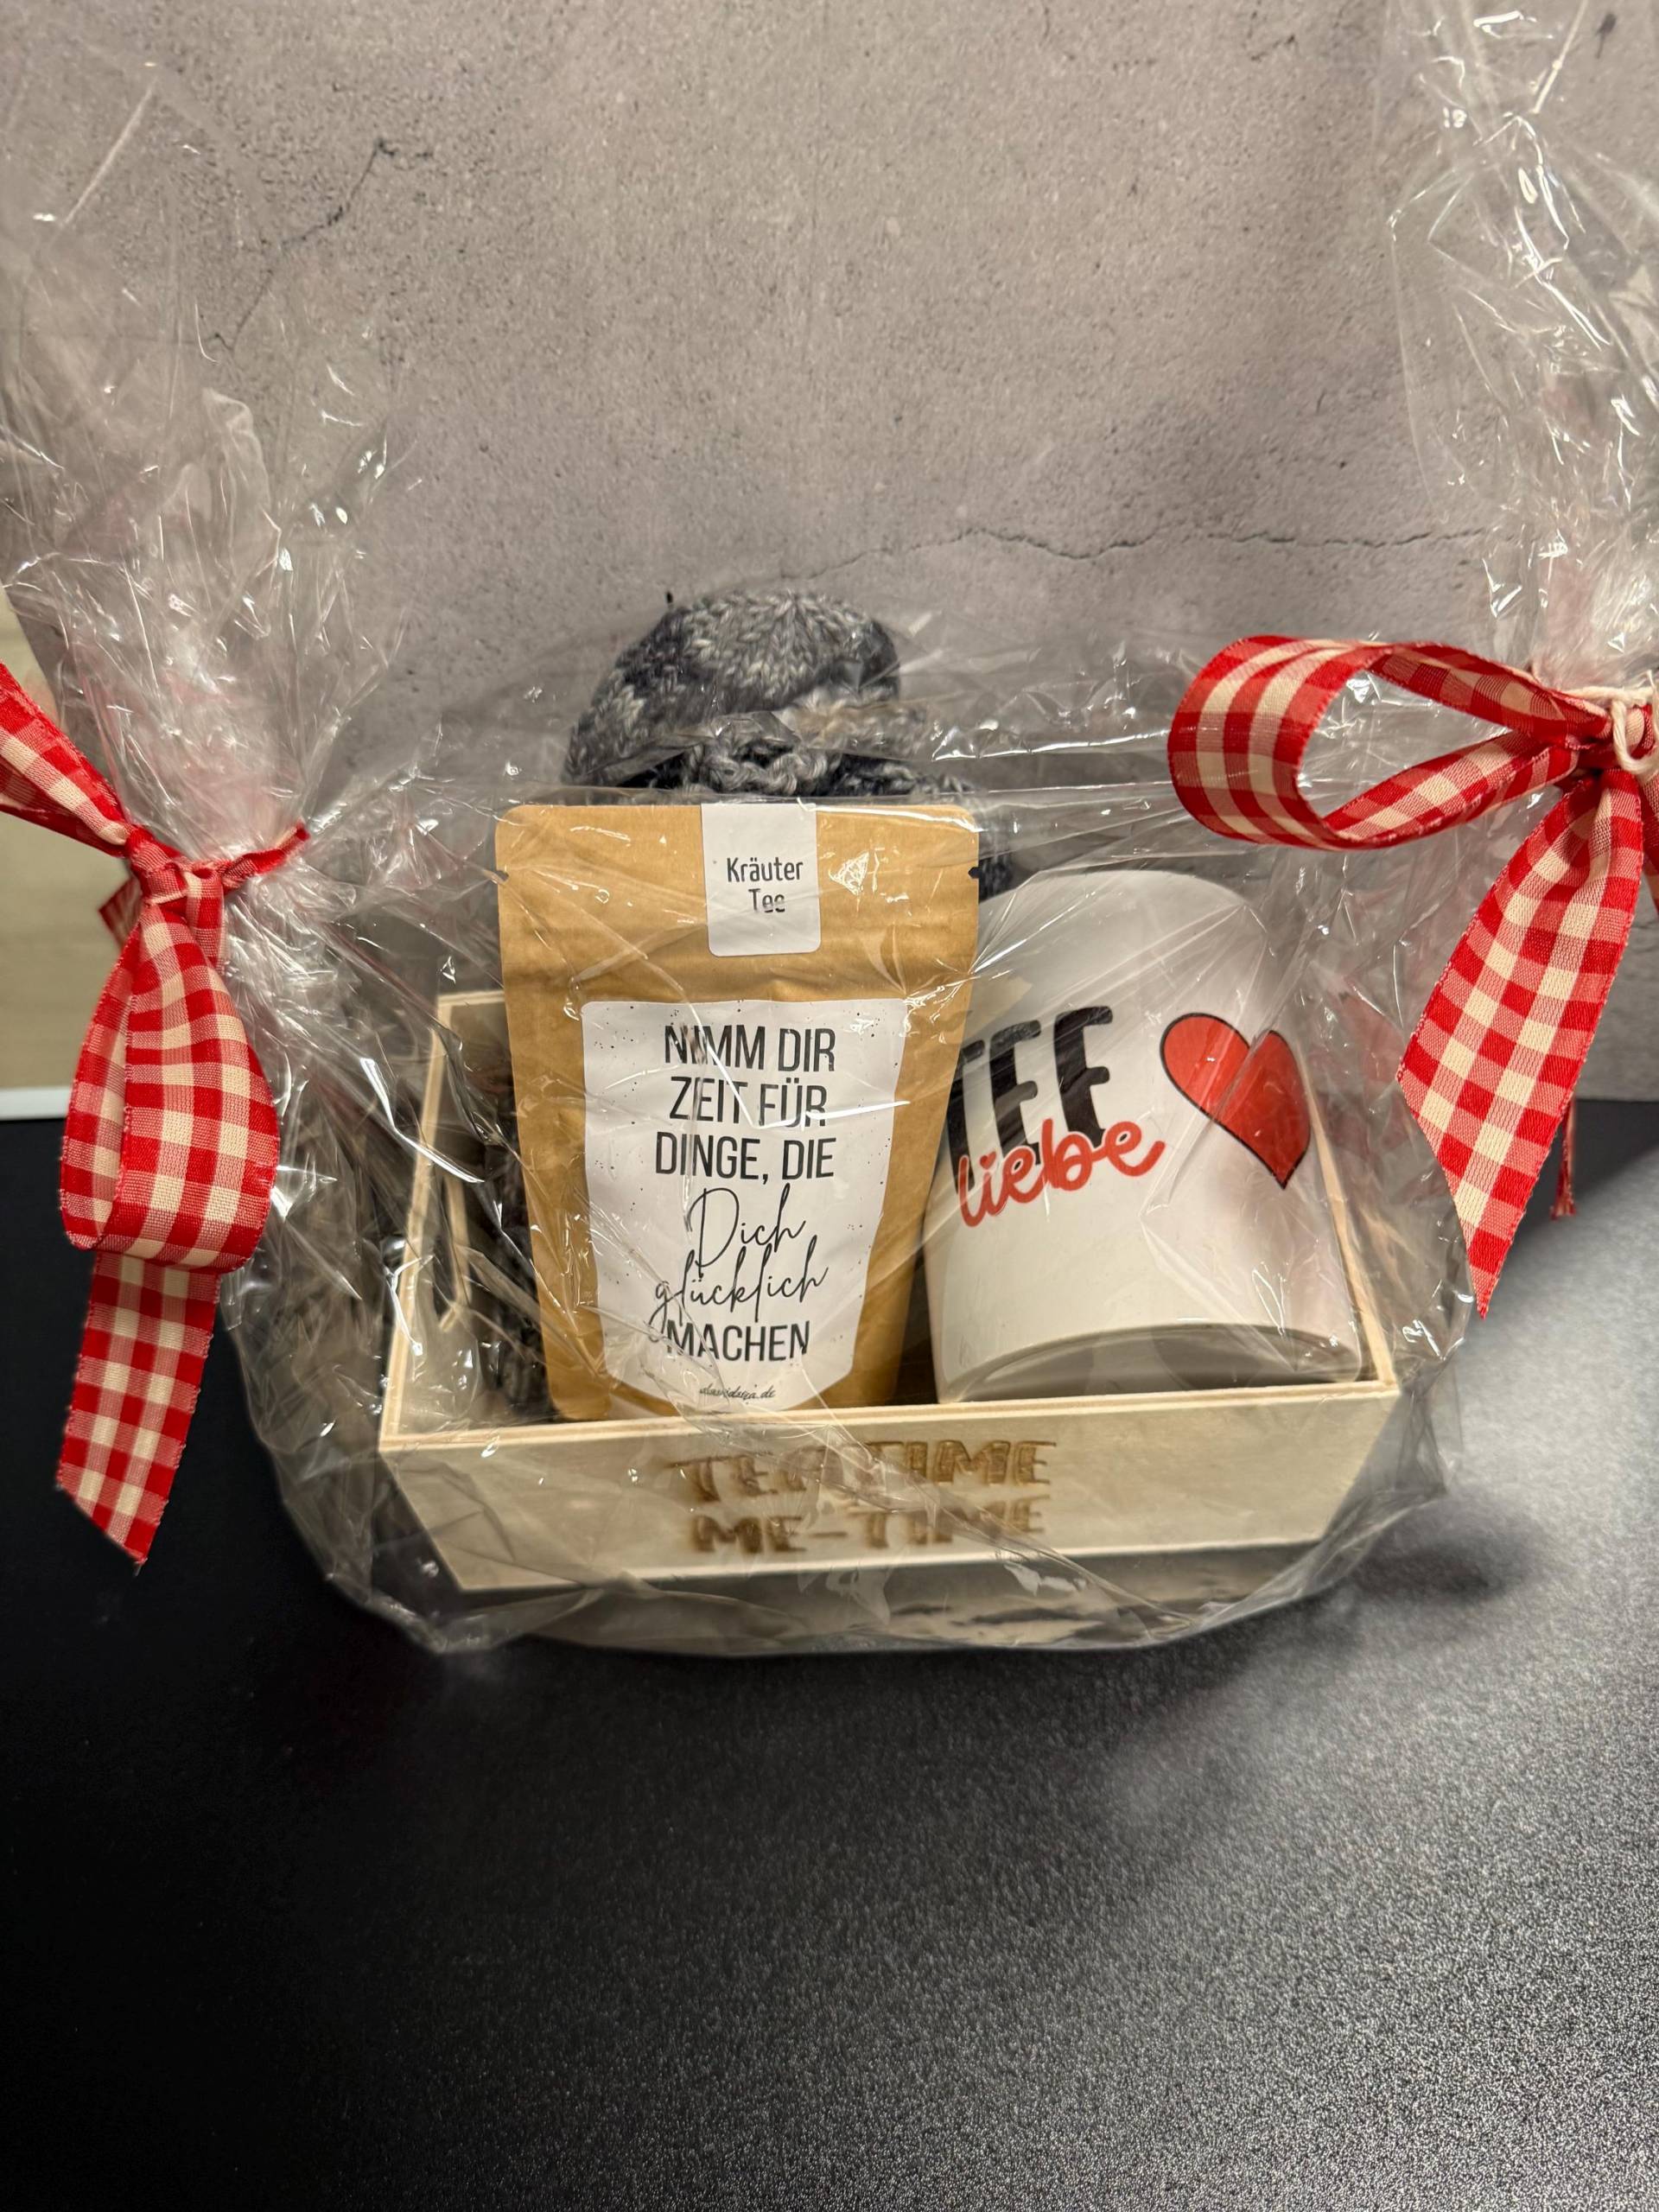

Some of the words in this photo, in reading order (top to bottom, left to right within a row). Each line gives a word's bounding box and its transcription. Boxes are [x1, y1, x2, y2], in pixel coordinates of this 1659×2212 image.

[726, 857, 804, 883] Kräuter
[748, 888, 786, 914] Tee
[664, 1024, 766, 1071] NIMM
[778, 1027, 836, 1072] DIR
[669, 1076, 748, 1124] ZEIT
[759, 1077, 828, 1128] FÜR
[655, 1131, 769, 1185] DINGE,
[782, 1137, 837, 1180] DIE
[957, 1117, 1166, 1228] liebe
[686, 1183, 806, 1278] Dich
[647, 1235, 830, 1343] glücklich
[666, 1320, 810, 1362] MACHEN
